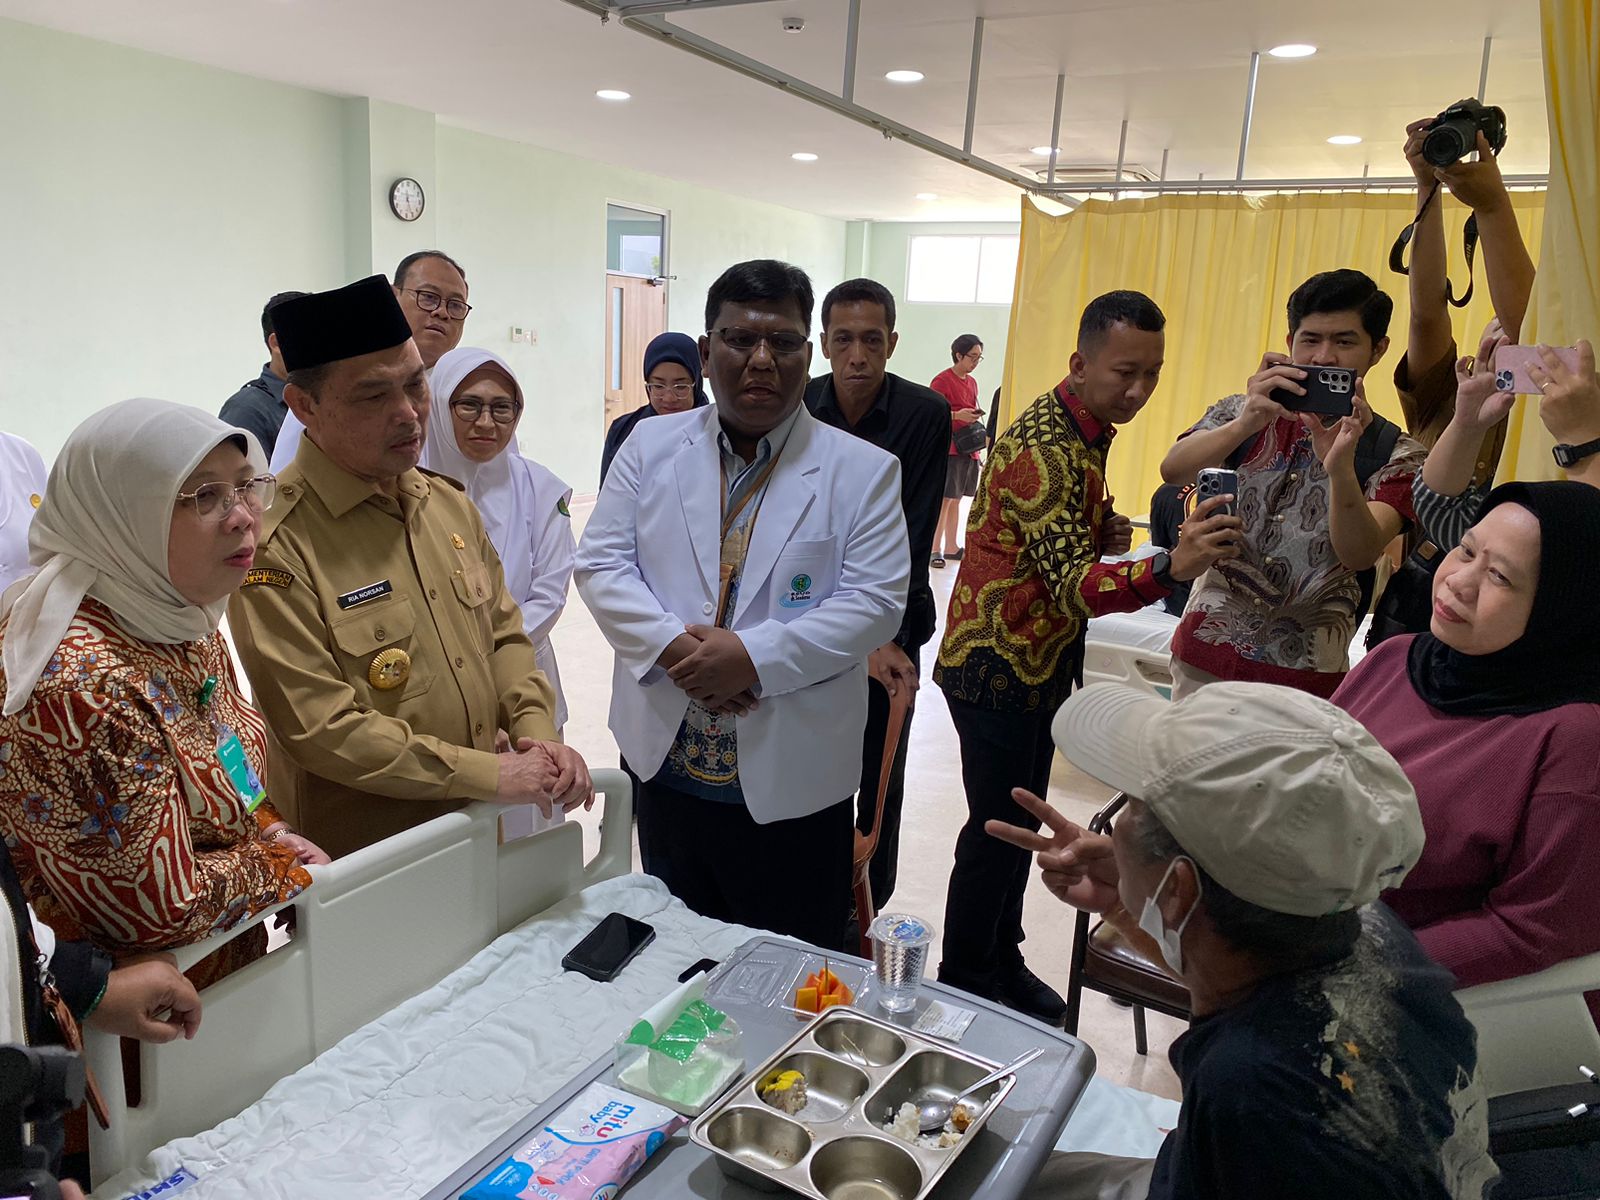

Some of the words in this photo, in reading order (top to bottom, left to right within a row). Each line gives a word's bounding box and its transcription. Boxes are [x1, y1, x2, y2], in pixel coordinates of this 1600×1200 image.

[247, 570, 291, 582] MENTERIAN
[358, 585, 385, 599] NORSAN
[589, 1101, 623, 1123] baby
[596, 1104, 637, 1138] mitu
